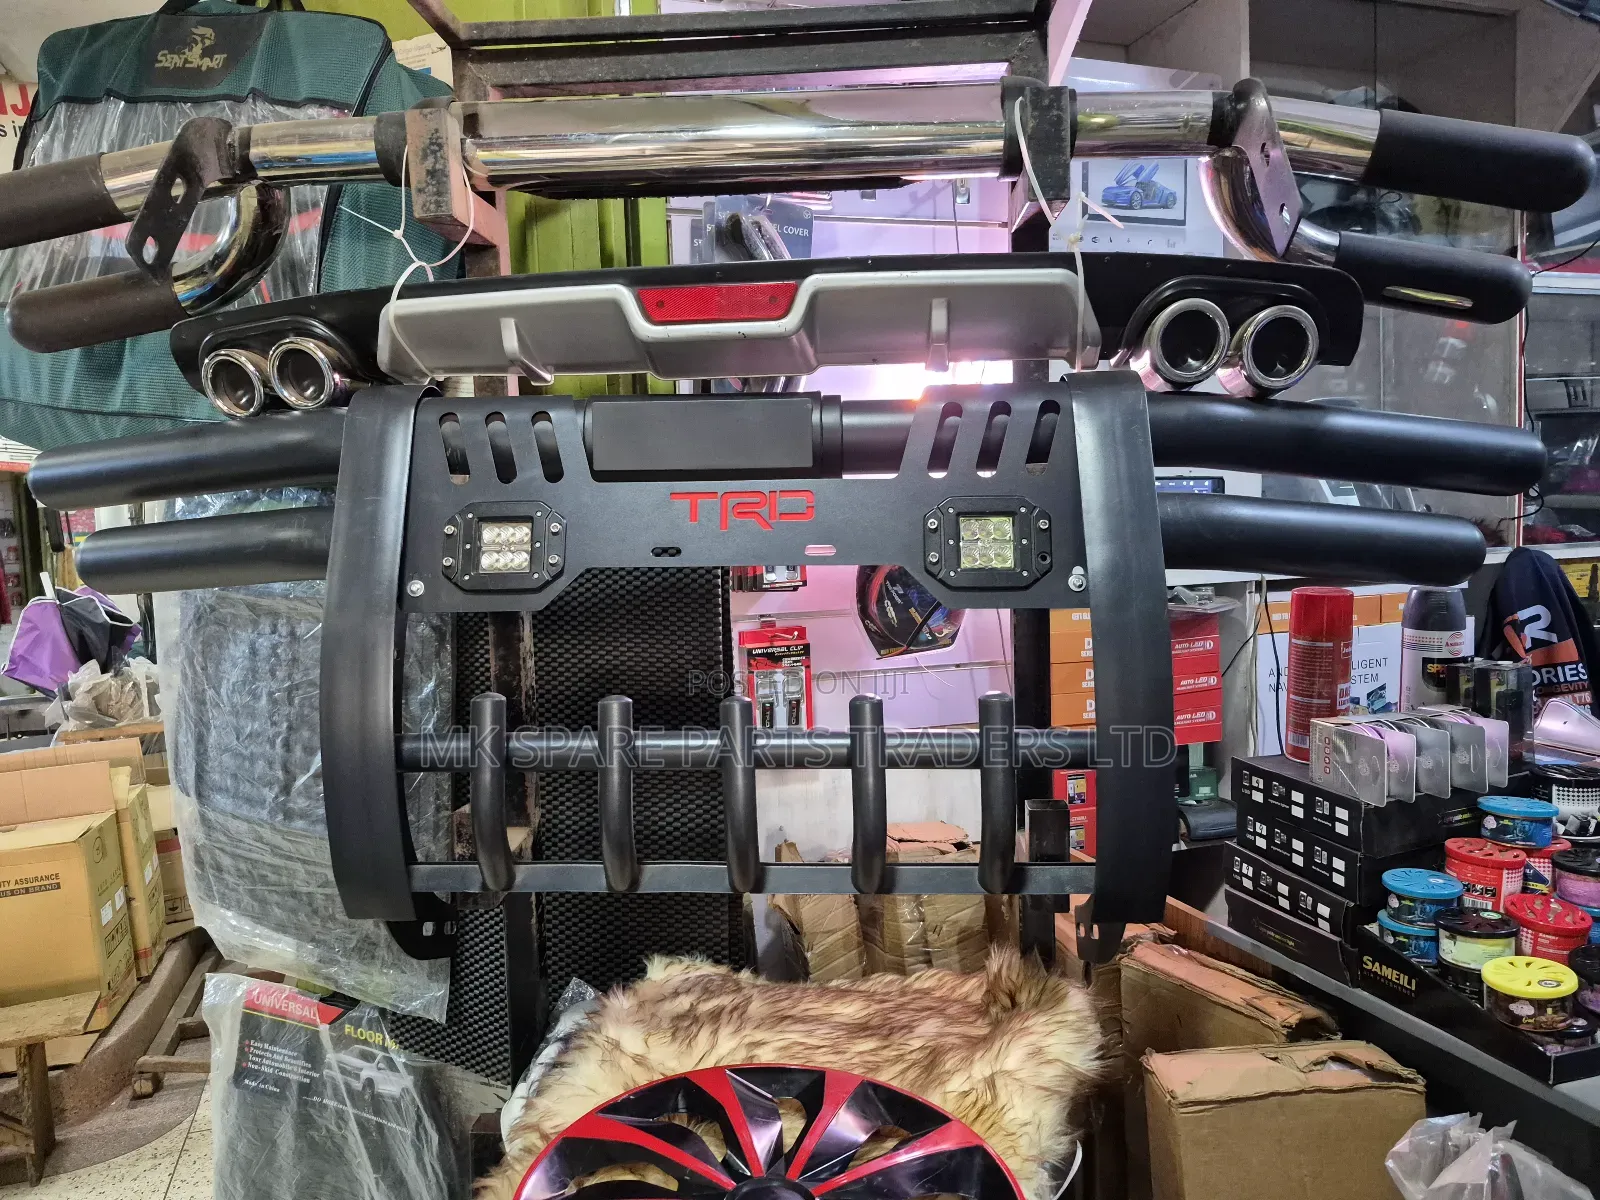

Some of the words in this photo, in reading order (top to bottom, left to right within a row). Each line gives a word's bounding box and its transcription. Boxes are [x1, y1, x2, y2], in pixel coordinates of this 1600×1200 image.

[783, 225, 810, 237] COVER
[669, 489, 815, 532] TRD
[752, 647, 789, 655] UNIVERSAL
[14, 872, 61, 887] ASSURANCE
[14, 888, 26, 896] ON
[28, 883, 59, 894] BRAND
[1362, 955, 1416, 991] SAMEILI
[253, 993, 318, 1020] UNIVERSAL
[344, 1023, 383, 1046] FLOOR
[250, 1039, 264, 1049] Easy
